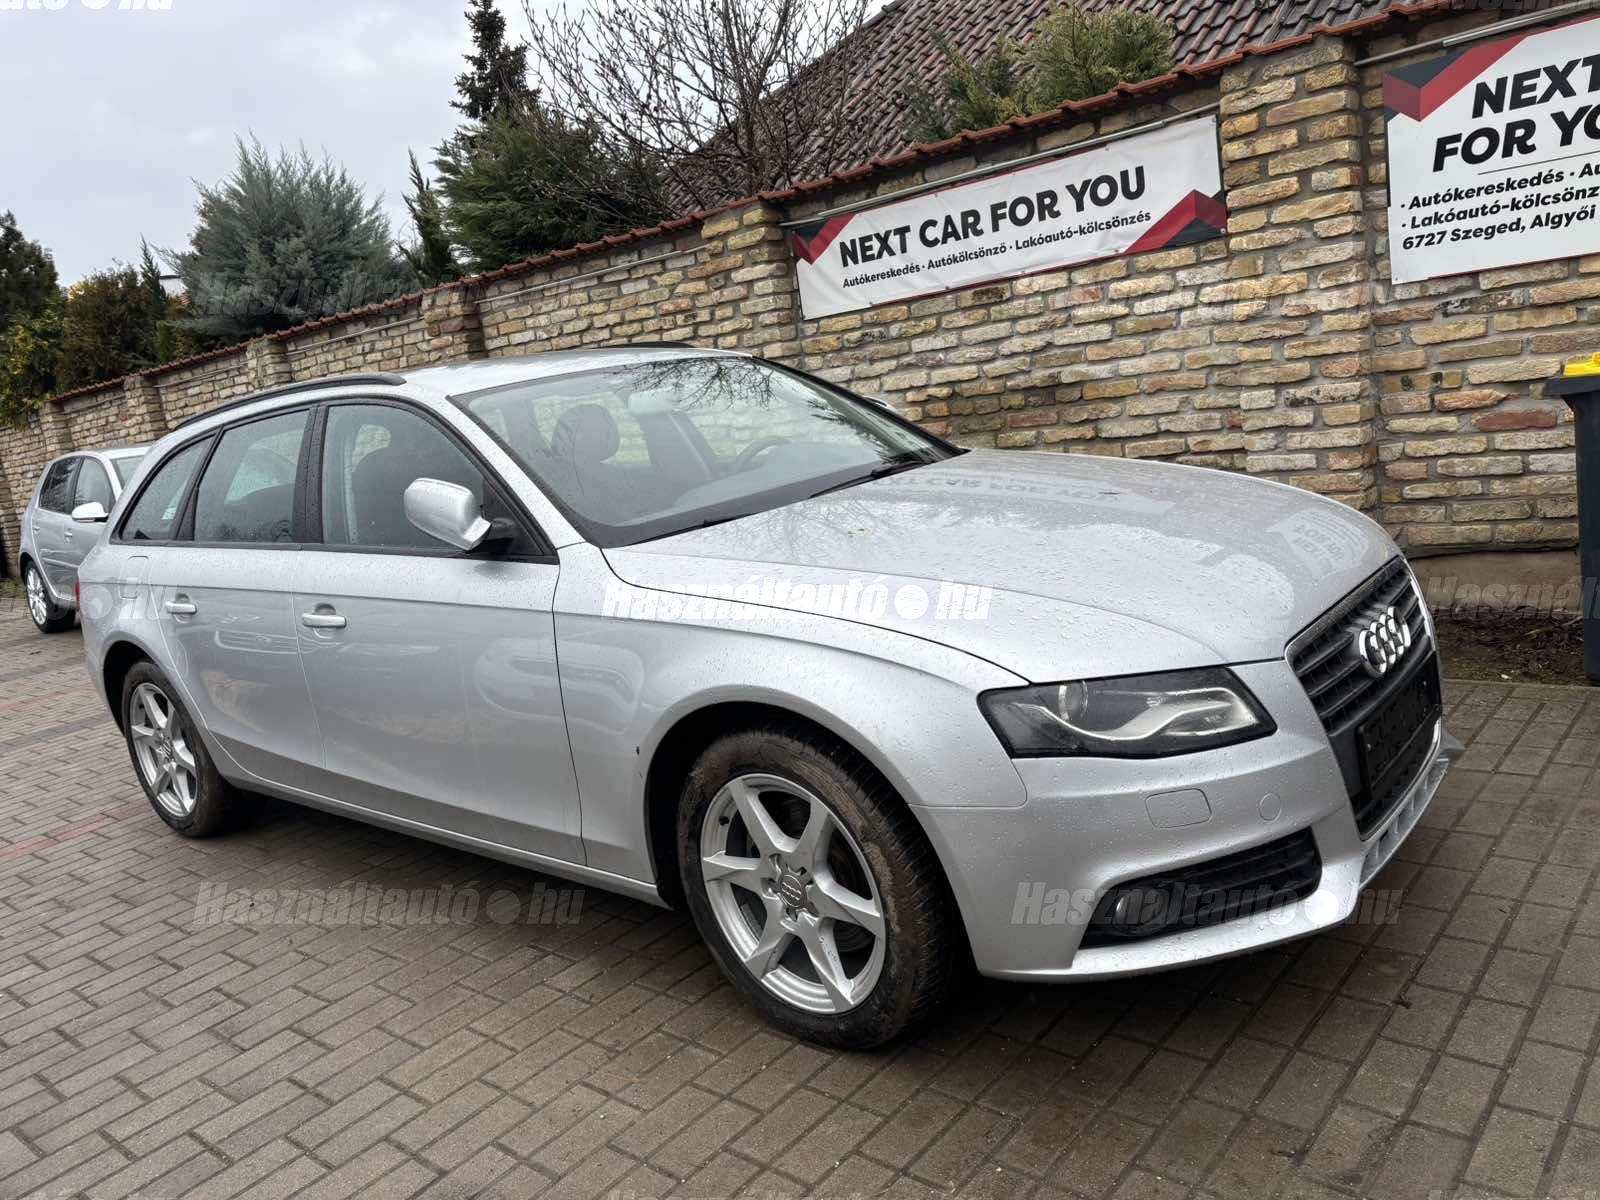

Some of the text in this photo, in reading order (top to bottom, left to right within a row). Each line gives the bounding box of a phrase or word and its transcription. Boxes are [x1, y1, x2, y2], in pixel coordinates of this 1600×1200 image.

[1472, 53, 1600, 119] NEXT
[1432, 118, 1536, 173] FOR
[839, 165, 1146, 267] NEXT CAR FOR YOU
[1408, 169, 1564, 210] Autókereskedés
[842, 263, 921, 288] Autókereskedés
[1015, 211, 1152, 251] Lakóautó-kölcsönzés
[1402, 204, 1596, 250] 6727 Szeged, Algyői
